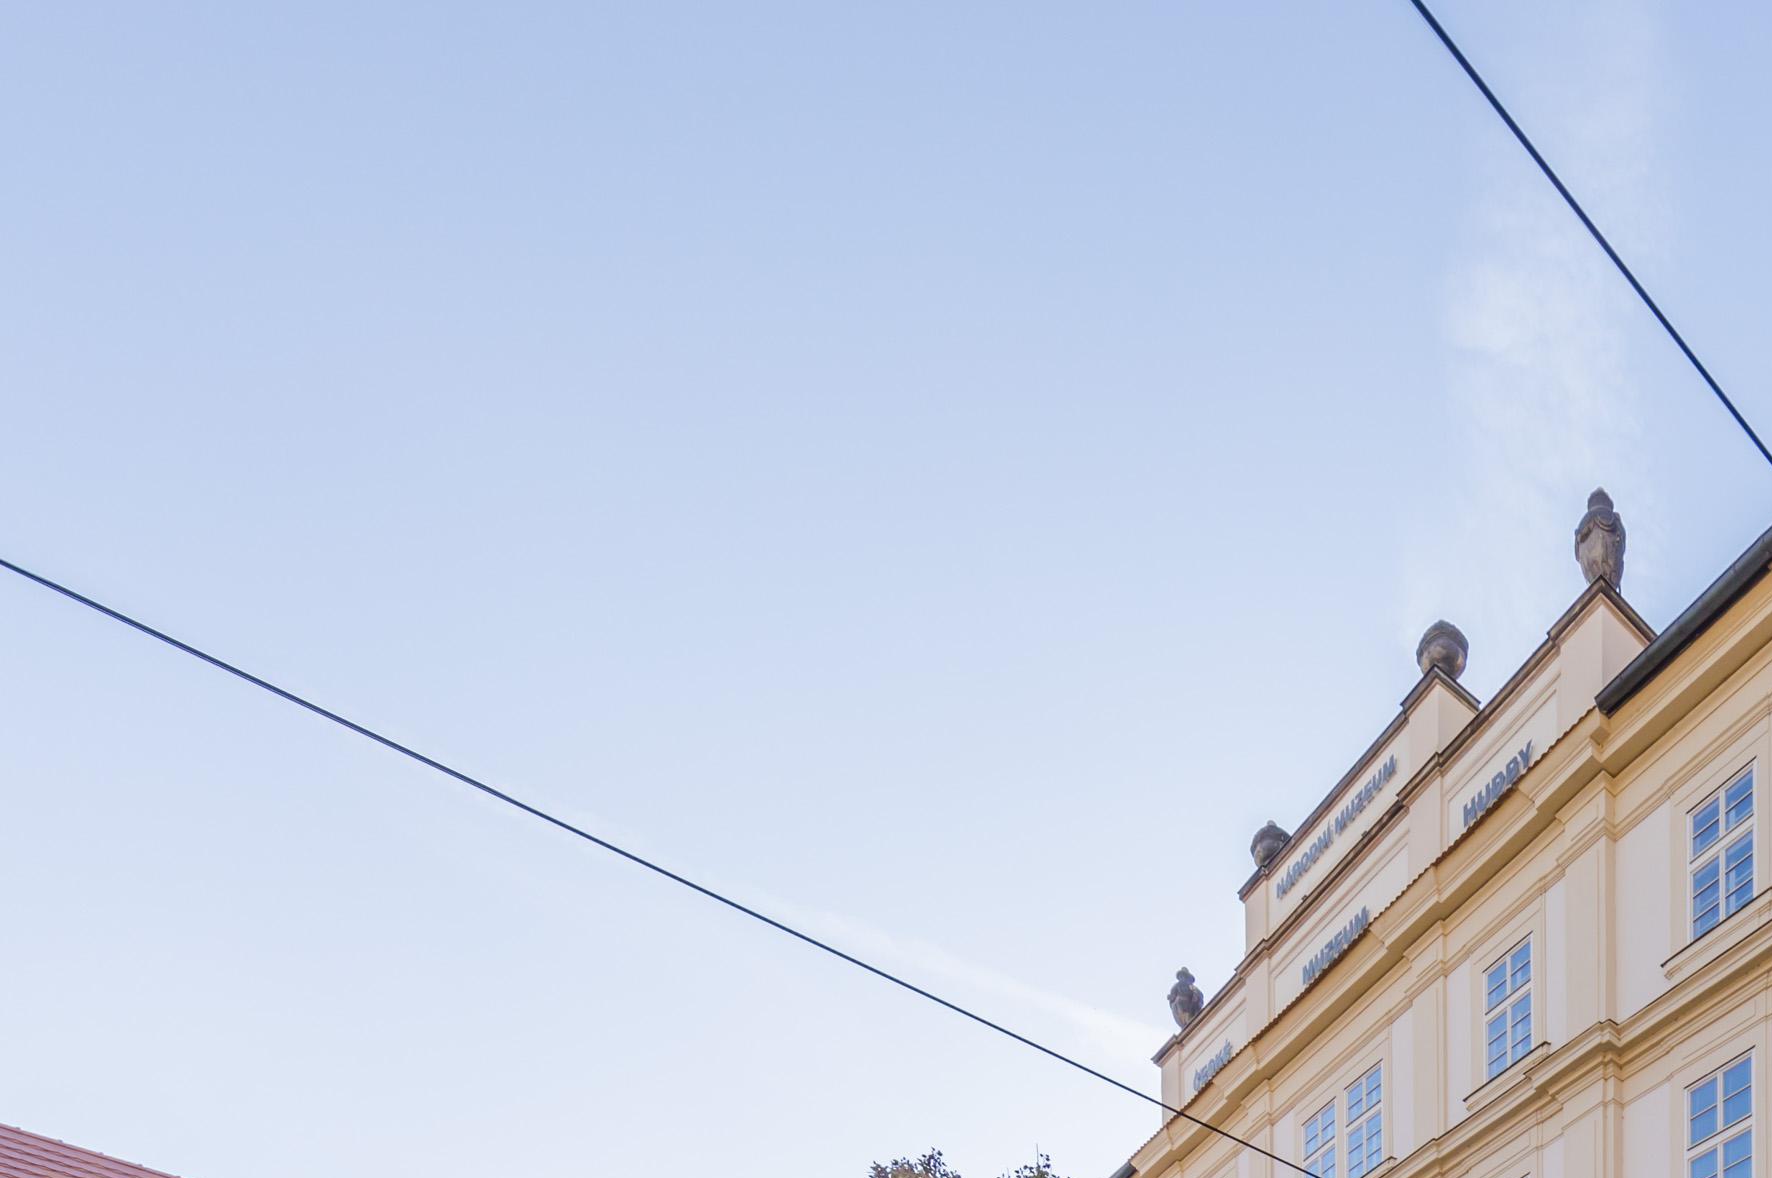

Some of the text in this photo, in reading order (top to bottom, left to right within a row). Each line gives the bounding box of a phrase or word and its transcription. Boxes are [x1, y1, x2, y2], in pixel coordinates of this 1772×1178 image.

[1276, 753, 1397, 899] NÁRODNÍ MUZEUM
[1302, 905, 1370, 986] MUZEUM
[1463, 738, 1533, 828] HUDBY
